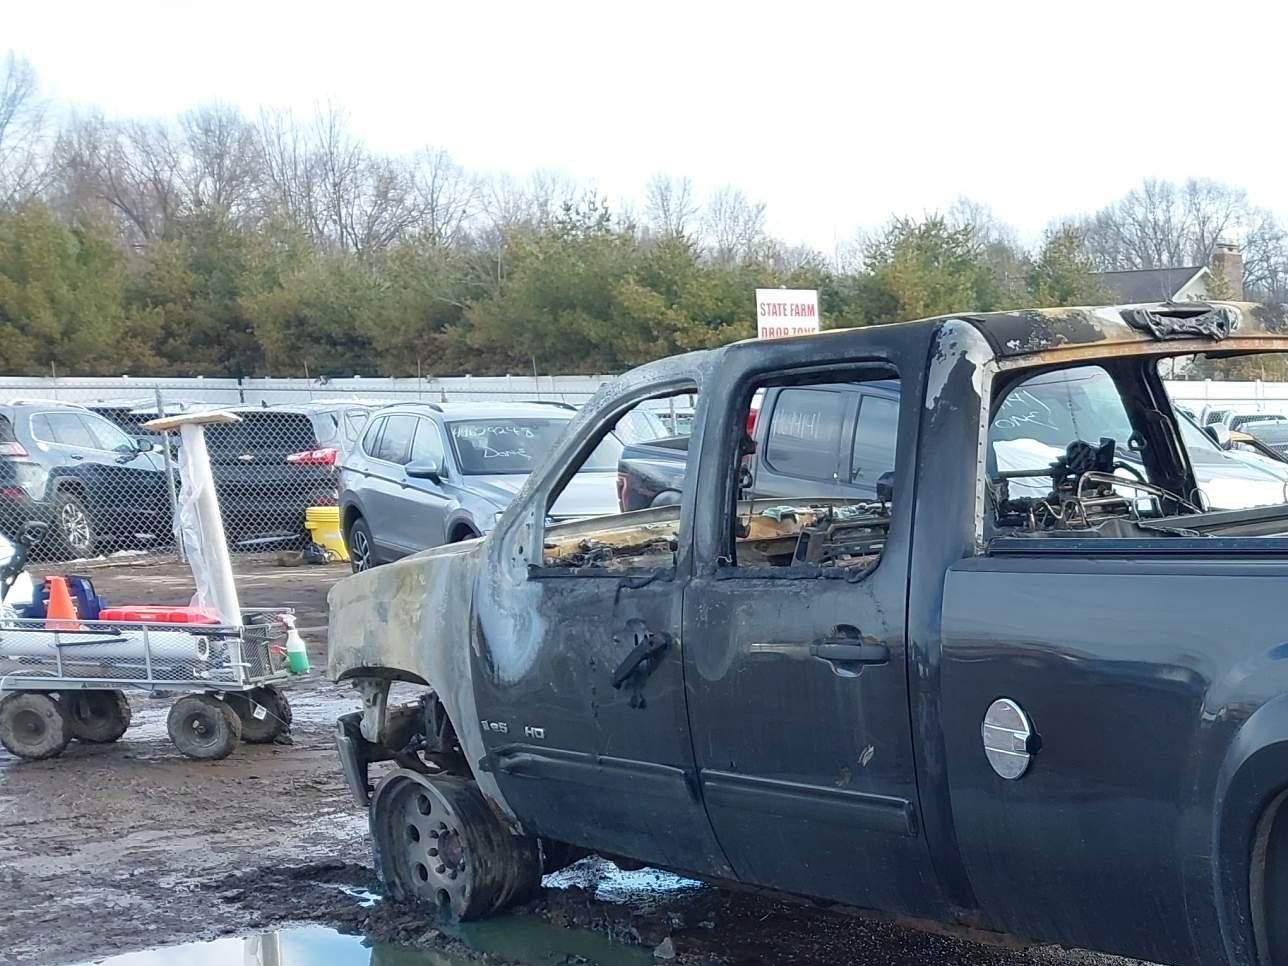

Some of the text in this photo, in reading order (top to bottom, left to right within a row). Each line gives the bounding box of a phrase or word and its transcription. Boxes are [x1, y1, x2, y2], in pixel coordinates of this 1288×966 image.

[760, 302, 816, 317] STATE FARM
[761, 326, 789, 339] DROP
[524, 725, 545, 739] HD
